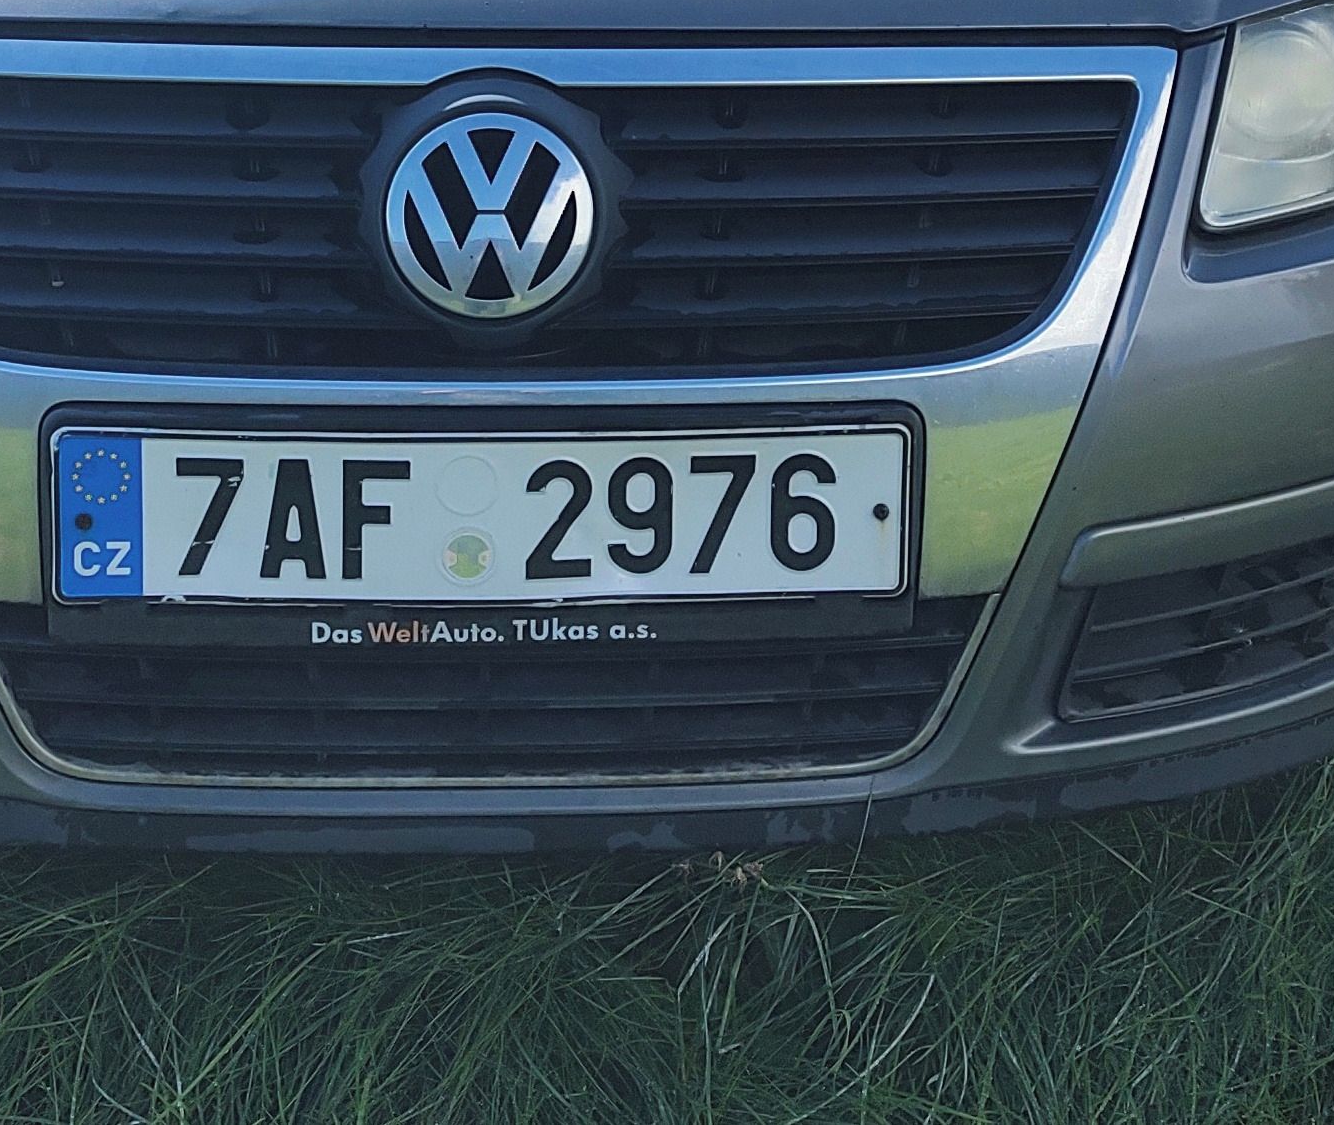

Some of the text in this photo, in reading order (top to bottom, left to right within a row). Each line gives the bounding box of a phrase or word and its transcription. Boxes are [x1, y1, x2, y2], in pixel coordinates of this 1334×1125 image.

[175, 453, 838, 580] 7AF 2976
[73, 540, 132, 578] CZ
[311, 618, 658, 644] Das WeltAuto. TUkas a.s.
